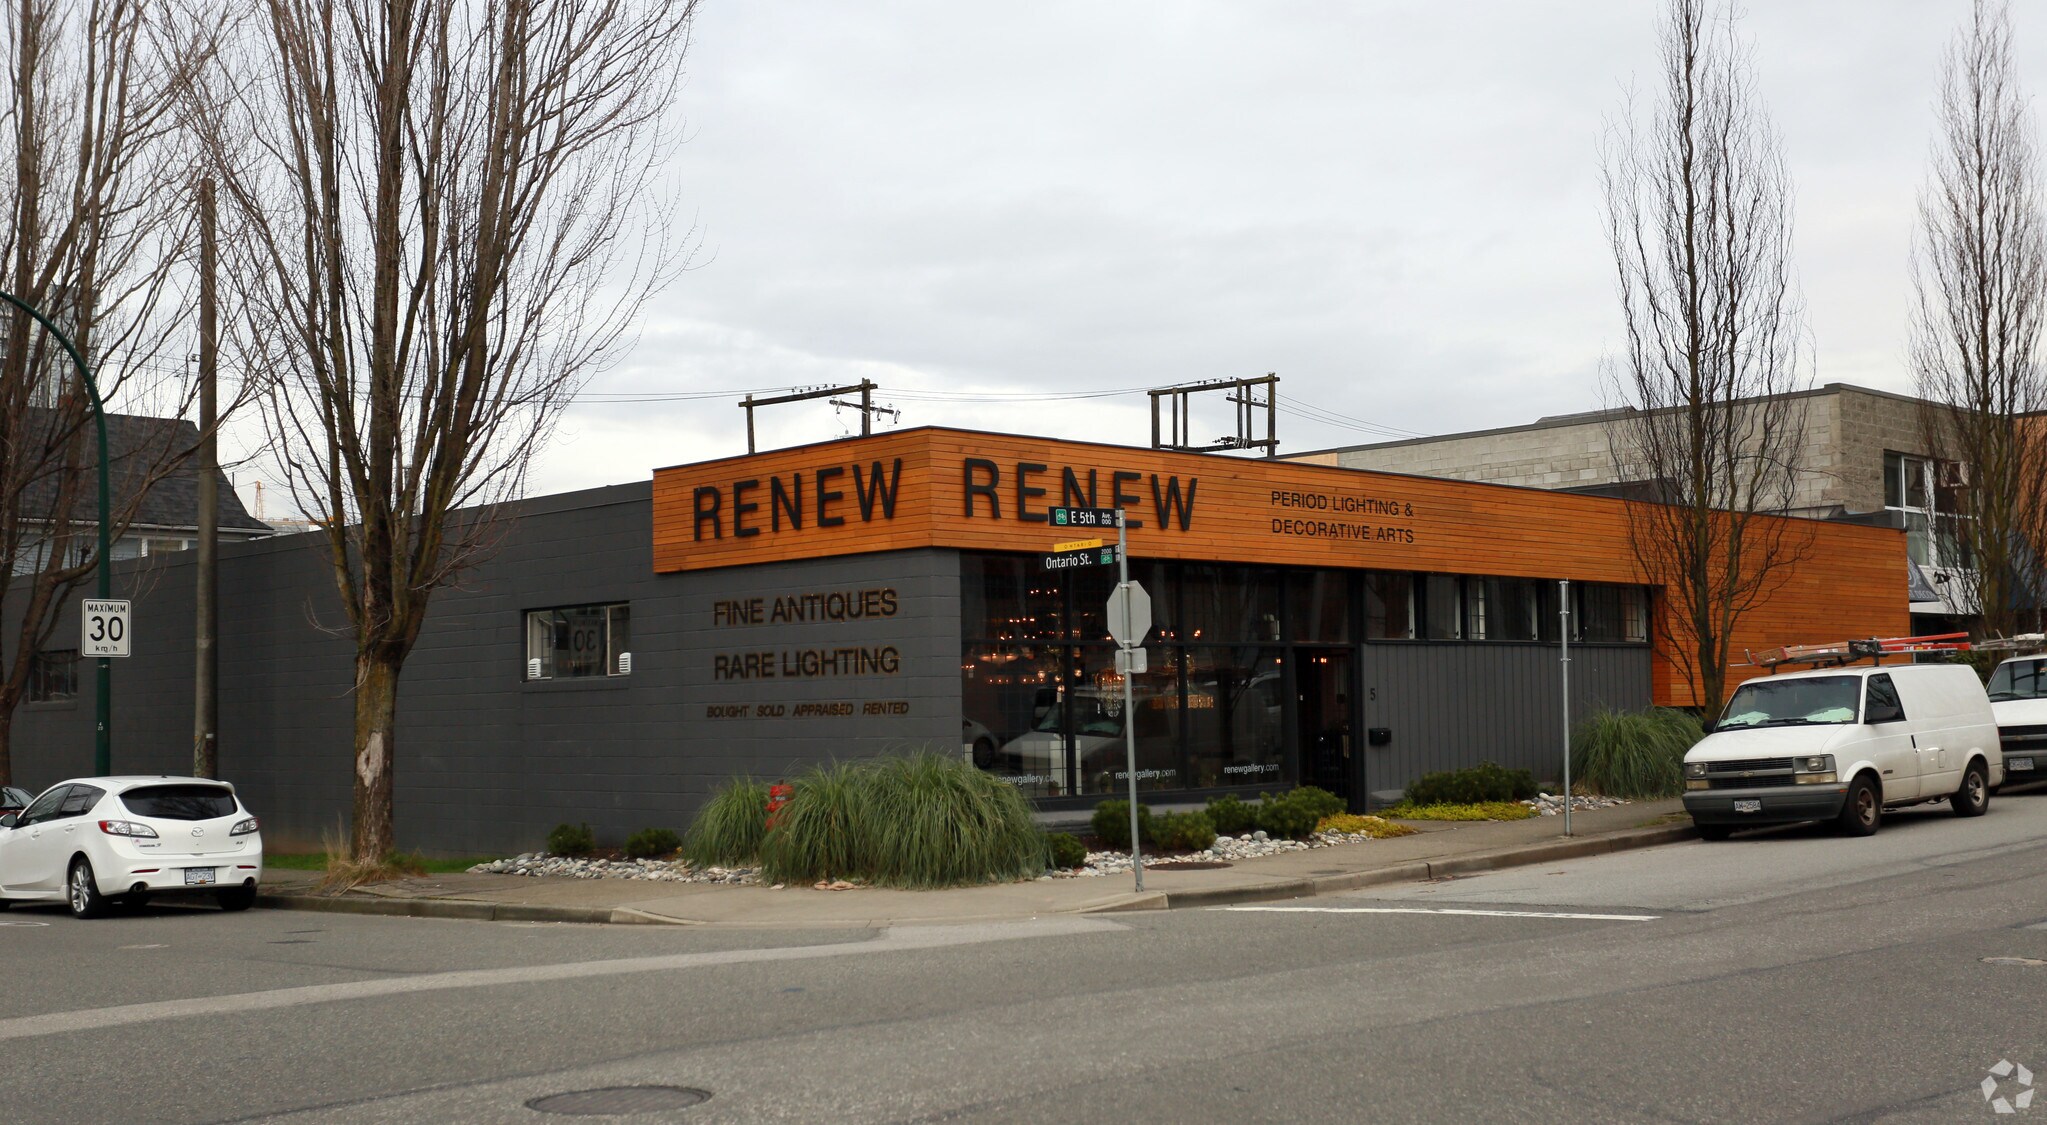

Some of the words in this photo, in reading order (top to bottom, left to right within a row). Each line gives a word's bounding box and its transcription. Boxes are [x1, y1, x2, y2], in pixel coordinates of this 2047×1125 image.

[693, 458, 902, 542] RENEW
[965, 457, 1198, 531] RENEW
[1271, 491, 1328, 510] PERIOD
[1333, 496, 1399, 516] LIGHTING
[1404, 502, 1414, 517] &
[1071, 511, 1077, 524] E
[1080, 511, 1096, 524] 5th
[1272, 518, 1371, 540] DECORATIVE
[1376, 527, 1414, 543] ARTS
[1064, 541, 1093, 549] ONTARIO
[1045, 554, 1078, 570] Ontario
[1079, 553, 1092, 566] St.
[87, 604, 126, 613] MAXIMUM
[713, 598, 764, 626] FINE
[771, 588, 898, 624] ANTIQUES
[90, 616, 124, 641] 30
[95, 645, 118, 653] km/h
[714, 653, 775, 680] RARE
[782, 646, 900, 678] LIGHTING
[1370, 688, 1376, 701] 5
[706, 705, 749, 718] BOUGHT
[756, 705, 785, 718] SOLD
[792, 703, 854, 717] APPRAISED
[862, 702, 910, 715] RENTED
[1115, 769, 1177, 780] renegallery.com
[1224, 764, 1279, 775] renewgallery.com
